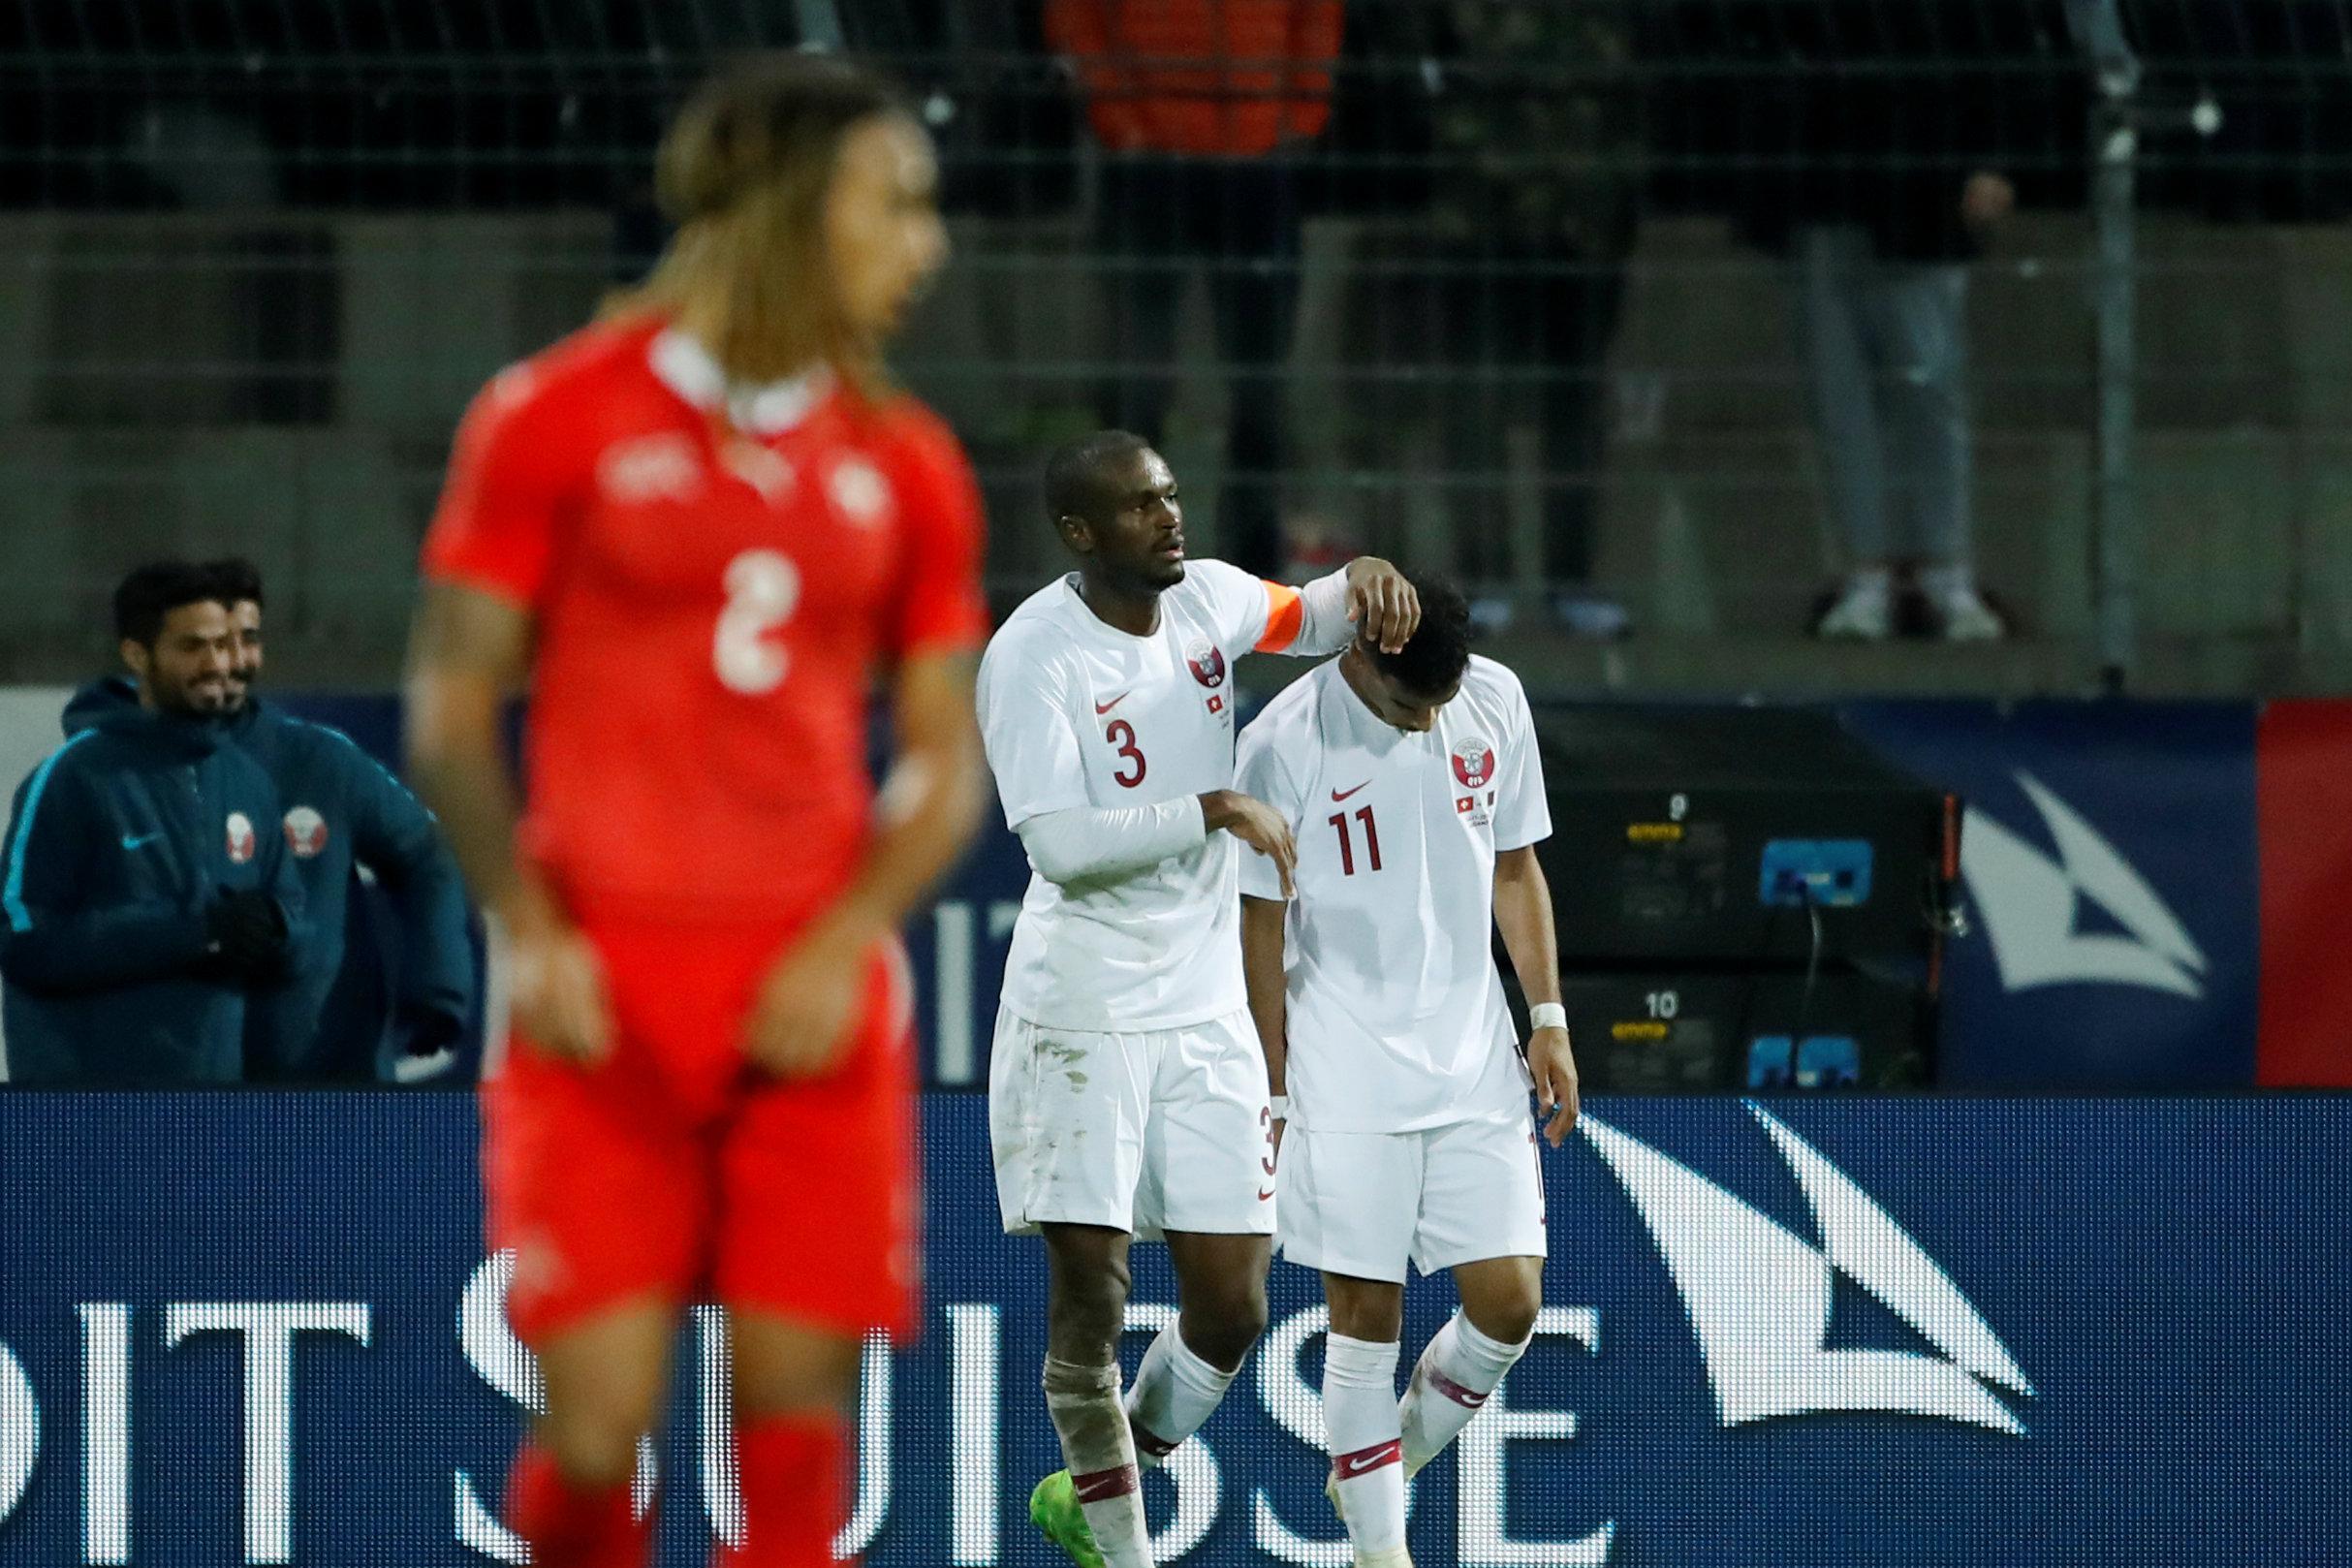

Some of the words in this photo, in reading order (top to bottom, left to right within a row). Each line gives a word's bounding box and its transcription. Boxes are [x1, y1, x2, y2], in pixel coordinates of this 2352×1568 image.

[713, 547, 802, 695] 2
[1106, 720, 1146, 788] 3
[1329, 804, 1382, 876] 11
[1669, 793, 1687, 821] 9
[1646, 990, 1678, 1019] 10
[0, 1301, 372, 1565] IT
